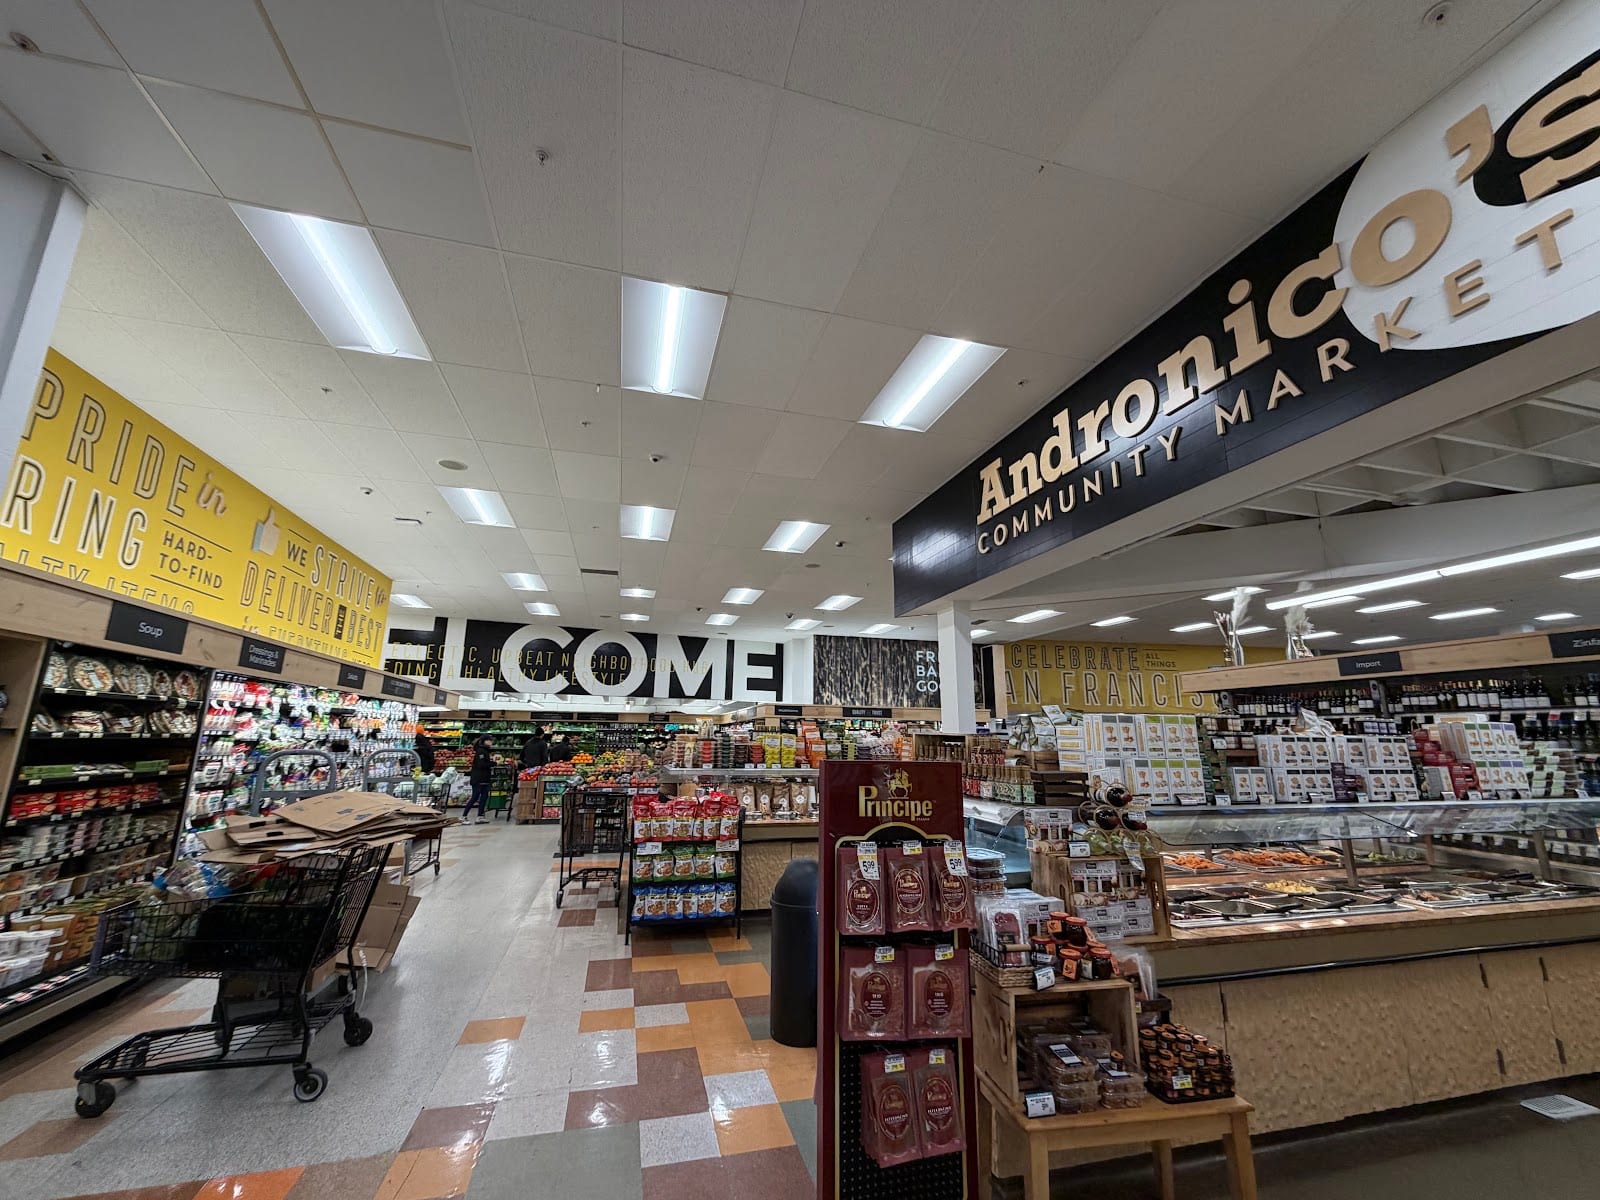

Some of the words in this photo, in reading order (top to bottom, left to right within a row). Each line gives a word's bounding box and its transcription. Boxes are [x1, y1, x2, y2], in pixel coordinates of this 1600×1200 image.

[976, 60, 1600, 526] Andronico's
[977, 426, 1183, 555] COMMUNITY
[1215, 208, 1574, 436] MARKET
[20, 367, 196, 518] PRIDE
[0, 454, 149, 570] RING
[163, 531, 213, 560] HARD-
[159, 553, 223, 589] TO-FIND
[287, 540, 308, 567] WE
[310, 544, 375, 612] STRIVE
[240, 560, 333, 635] DELIVER
[346, 609, 382, 652] BEST
[138, 622, 163, 638] Soup
[447, 664, 455, 679] A
[464, 665, 536, 682] HEALTHY
[492, 648, 554, 666] UPBEAT
[561, 653, 675, 673] NEIGHBORHOOD
[1011, 644, 1140, 670] CELEBRATE
[1146, 660, 1176, 668] THINGS
[1355, 661, 1381, 669] Import
[859, 785, 933, 821] Principe
